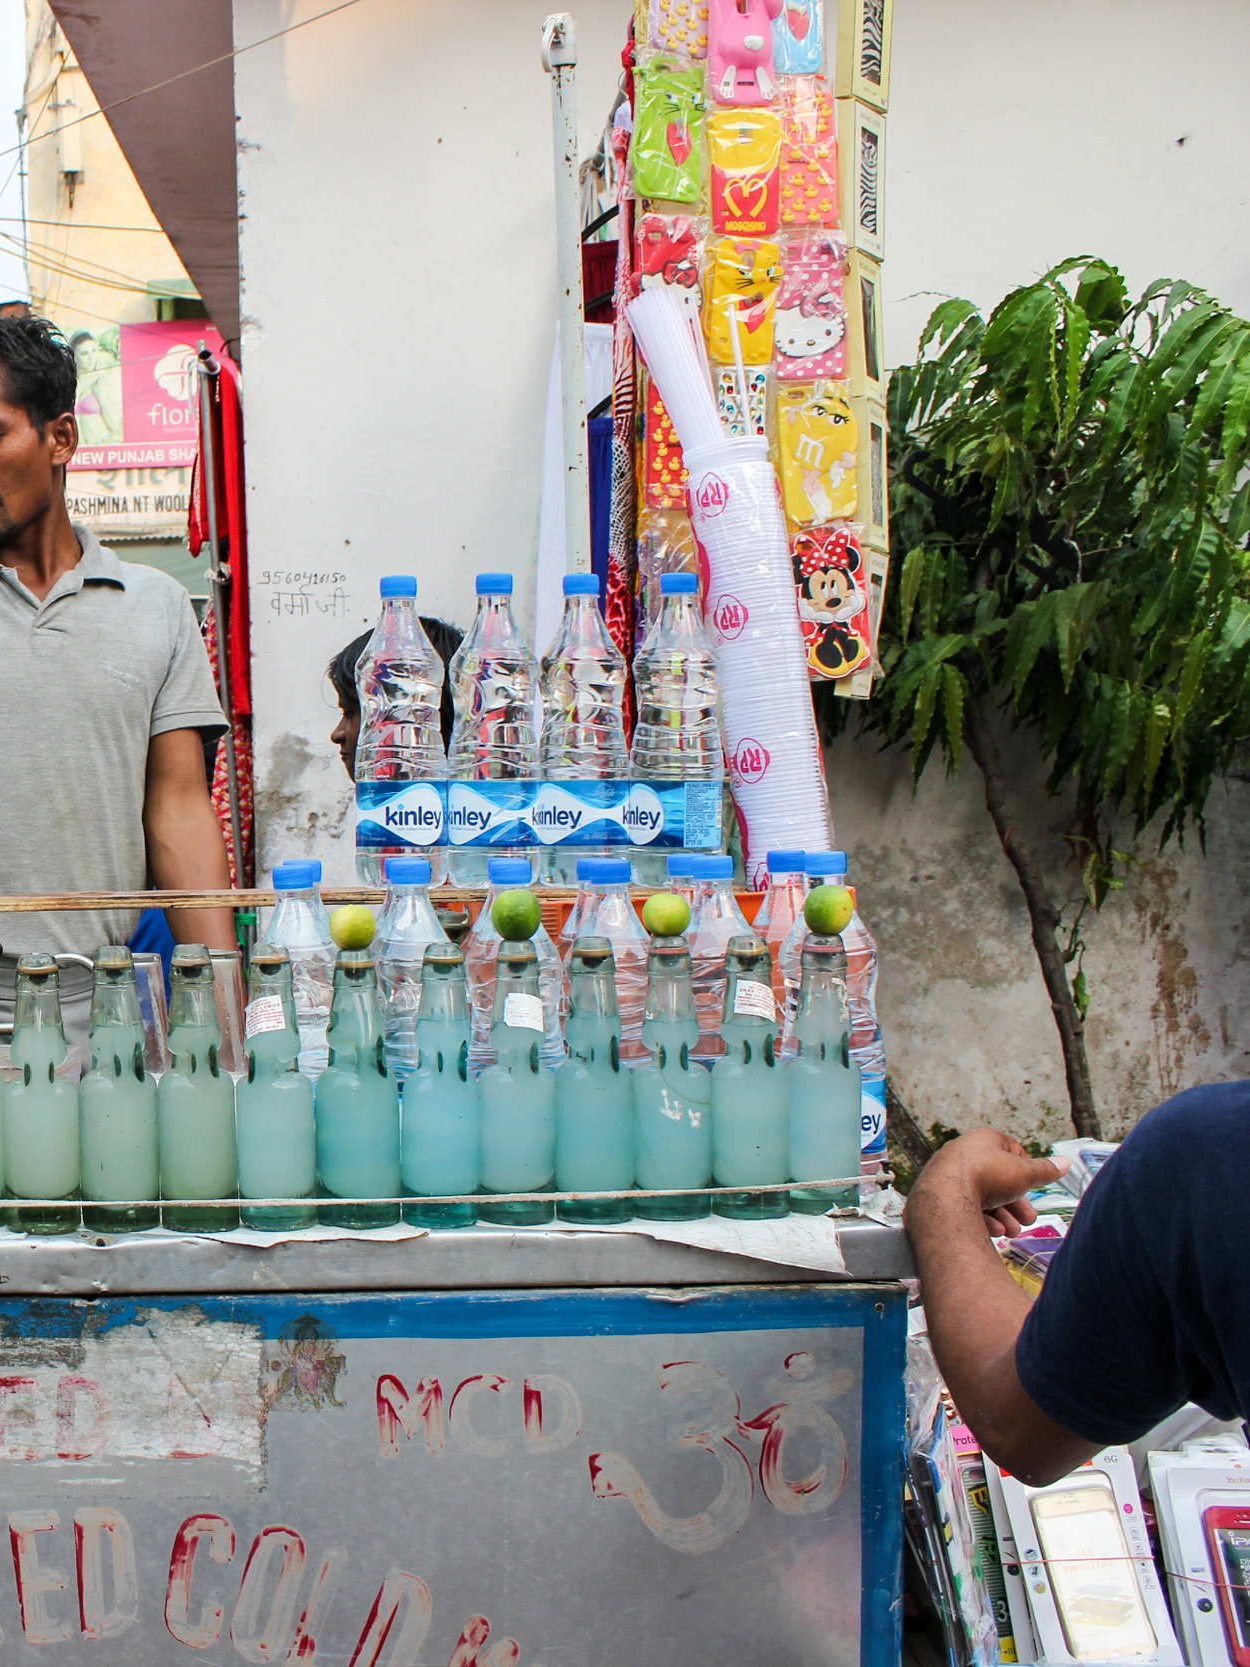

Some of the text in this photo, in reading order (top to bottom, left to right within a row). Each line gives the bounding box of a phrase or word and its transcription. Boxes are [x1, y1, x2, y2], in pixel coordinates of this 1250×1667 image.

[725, 221, 767, 231] MOSCHINO
[71, 452, 104, 465] NEW
[107, 449, 165, 464] PUNJAB
[66, 494, 129, 515] PASHMINA
[740, 747, 762, 773] RP
[385, 803, 441, 829] kinley
[532, 803, 582, 829] kinley
[376, 1373, 582, 1459] MCD
[1103, 1455, 1118, 1463] 6G
